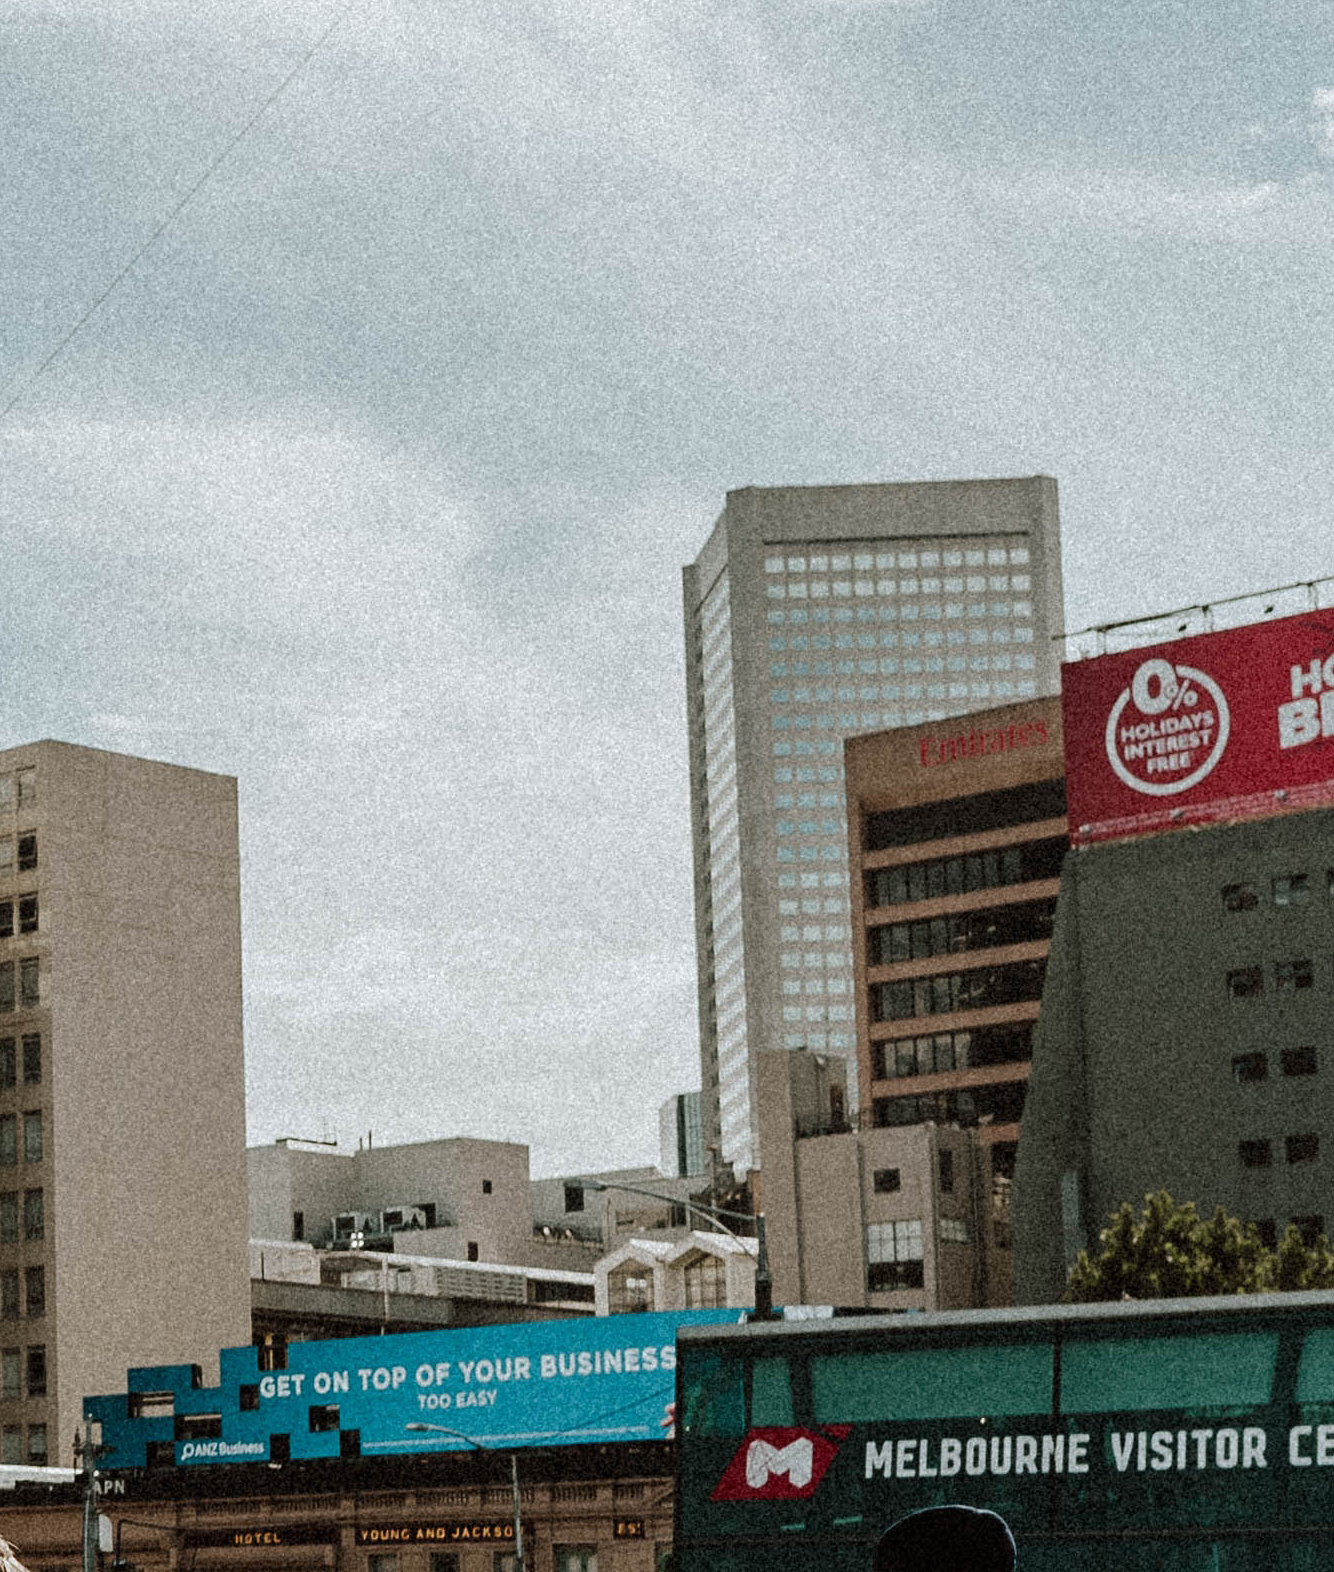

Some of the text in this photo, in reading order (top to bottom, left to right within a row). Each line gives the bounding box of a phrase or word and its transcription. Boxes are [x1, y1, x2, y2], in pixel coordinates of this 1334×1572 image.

[1132, 658, 1198, 715] 0%
[1121, 710, 1214, 742] HOLIDAYS
[918, 718, 1049, 767] Emirates
[1124, 729, 1212, 760] INTEREST
[1147, 751, 1190, 774] FREE
[260, 1345, 676, 1398] GET ON TOP OF YOUR BUSINESS
[418, 1389, 497, 1410] TOO EASY
[195, 1442, 264, 1457] ANZ Business
[865, 1433, 1090, 1479] MELBOURNE
[1112, 1427, 1267, 1472] VISITOR
[93, 1480, 124, 1495] APN
[235, 1532, 281, 1545] HOTEL
[361, 1529, 409, 1541] YOUNG
[416, 1528, 446, 1540] AND
